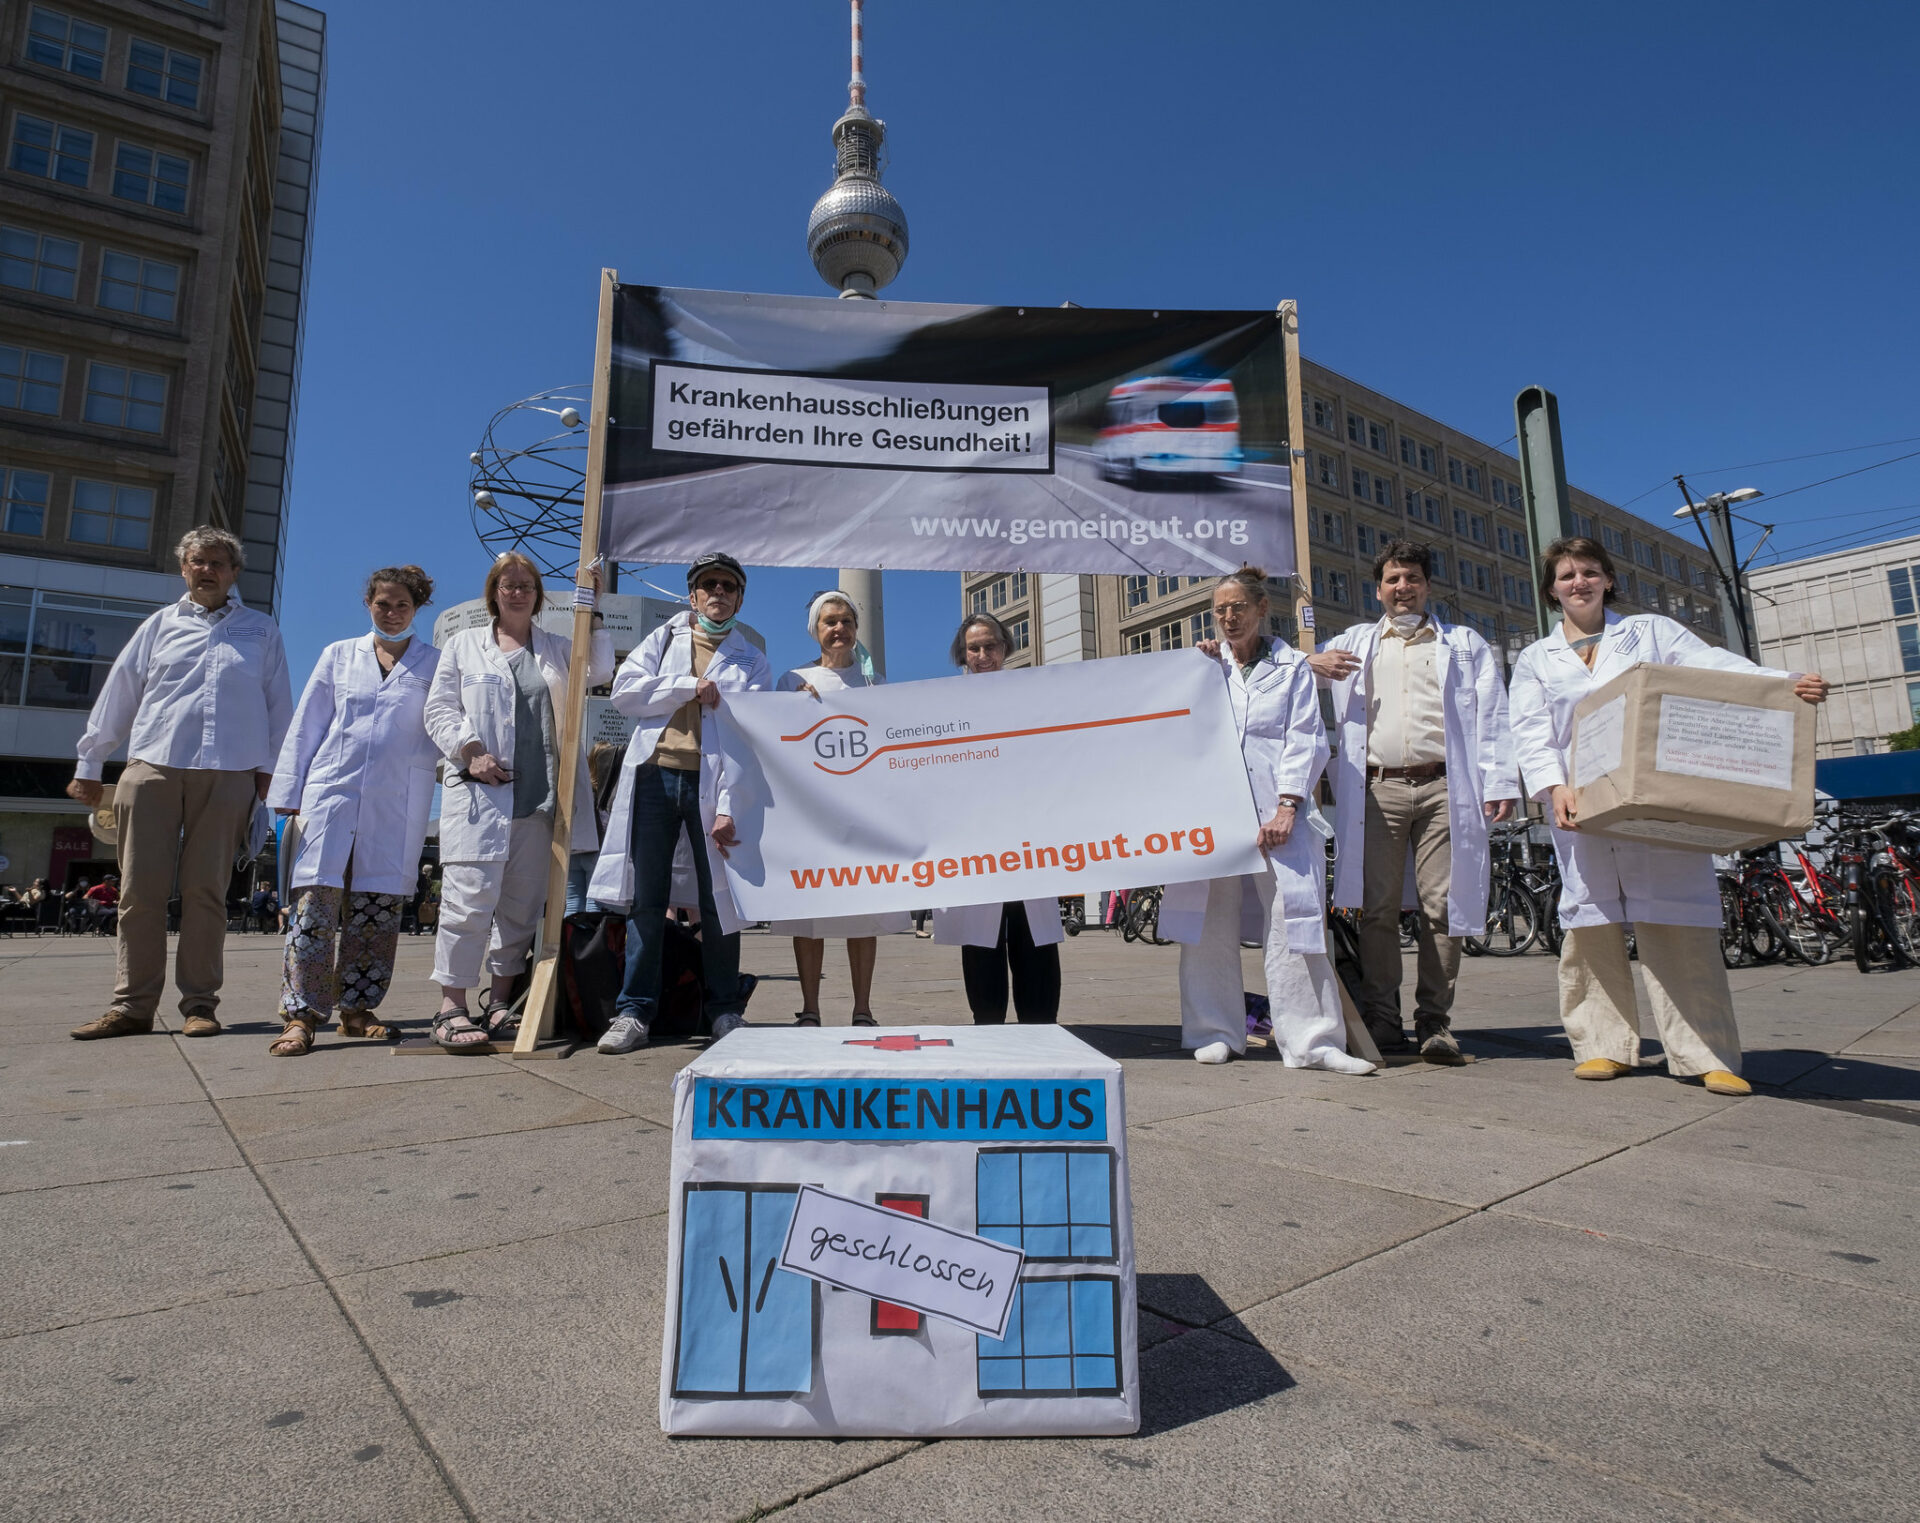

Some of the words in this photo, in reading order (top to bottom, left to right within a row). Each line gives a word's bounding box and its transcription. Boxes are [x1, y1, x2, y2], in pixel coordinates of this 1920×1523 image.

[670, 381, 1029, 426] Krankenhausschließungen
[668, 417, 803, 445] gefährden
[813, 424, 864, 448] Ihre
[872, 428, 1032, 454] Gesundheit!
[910, 513, 1249, 546] www.gemeingut.org
[814, 730, 869, 760] GiB
[885, 721, 955, 741] Gemeingut
[958, 719, 971, 731] in
[888, 746, 1000, 770] BürgerInnenhand
[55, 841, 89, 851] SALE
[790, 826, 1215, 890] www.gemeingut.org
[707, 1086, 1095, 1130] KRANKENHAUS
[810, 1224, 994, 1299] geschlossen
